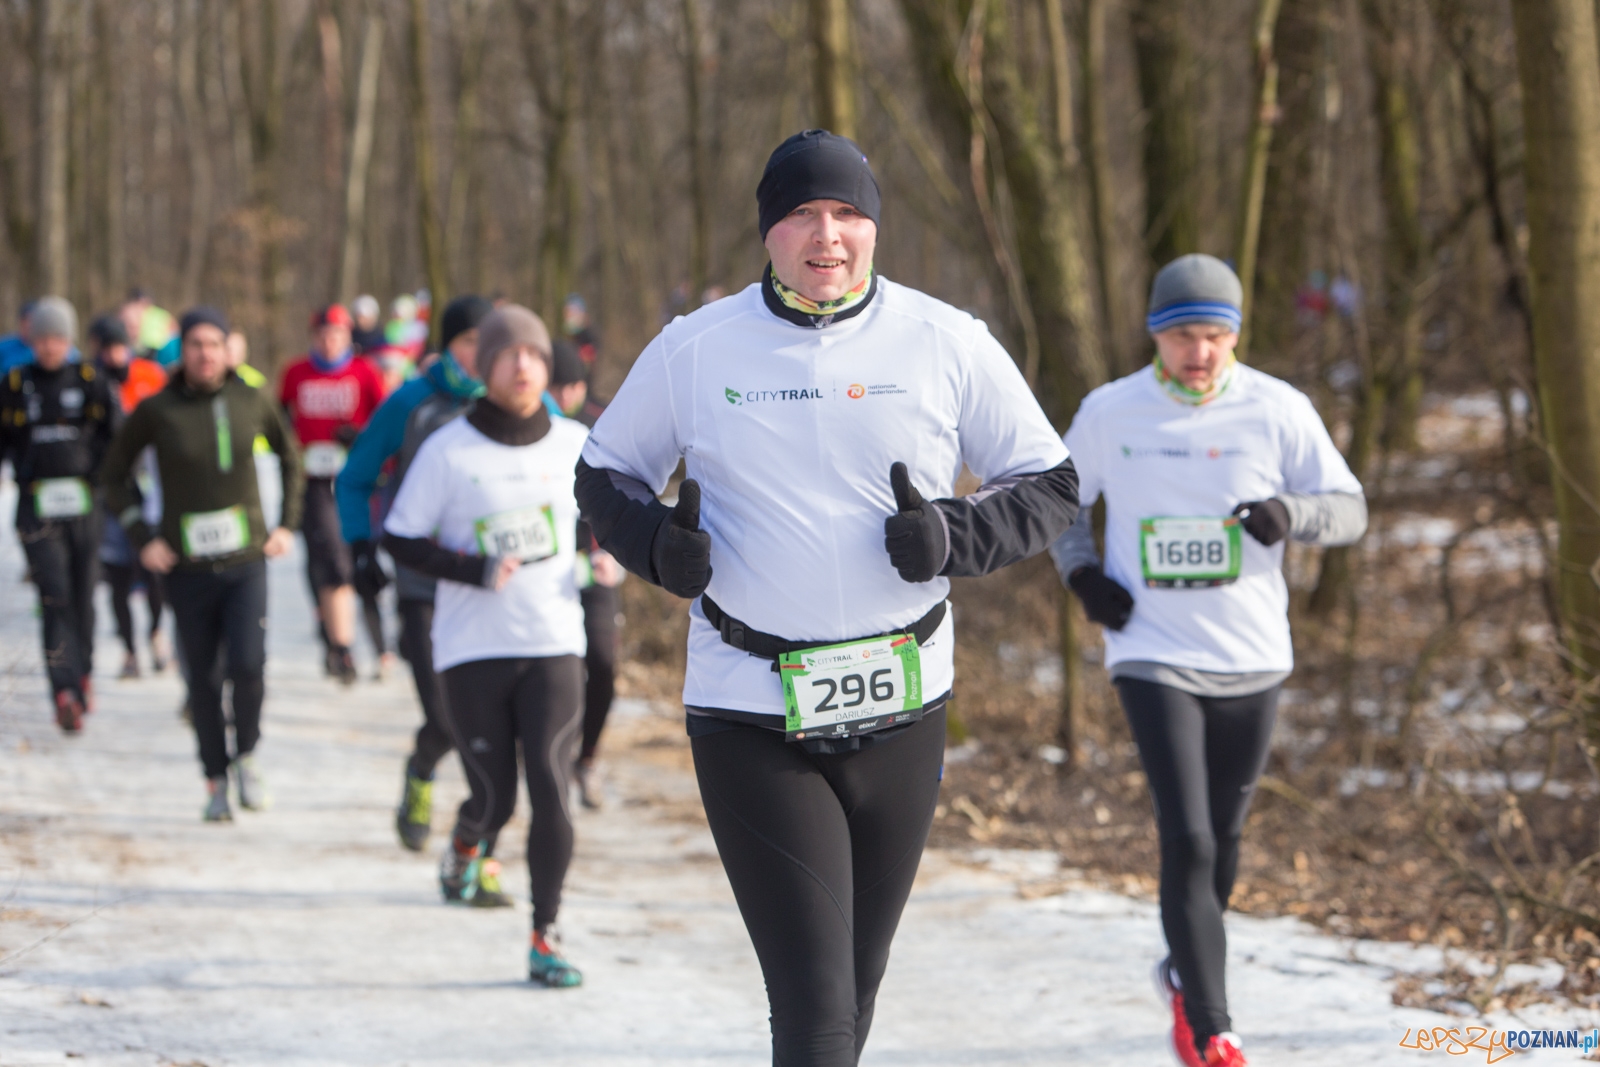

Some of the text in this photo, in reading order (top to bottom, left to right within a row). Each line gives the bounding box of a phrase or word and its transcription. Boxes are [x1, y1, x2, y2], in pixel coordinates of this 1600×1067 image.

[1155, 540, 1224, 566] 1688
[812, 668, 894, 713] 296
[910, 671, 918, 700] Poznań
[835, 707, 875, 722] DARIUSZ
